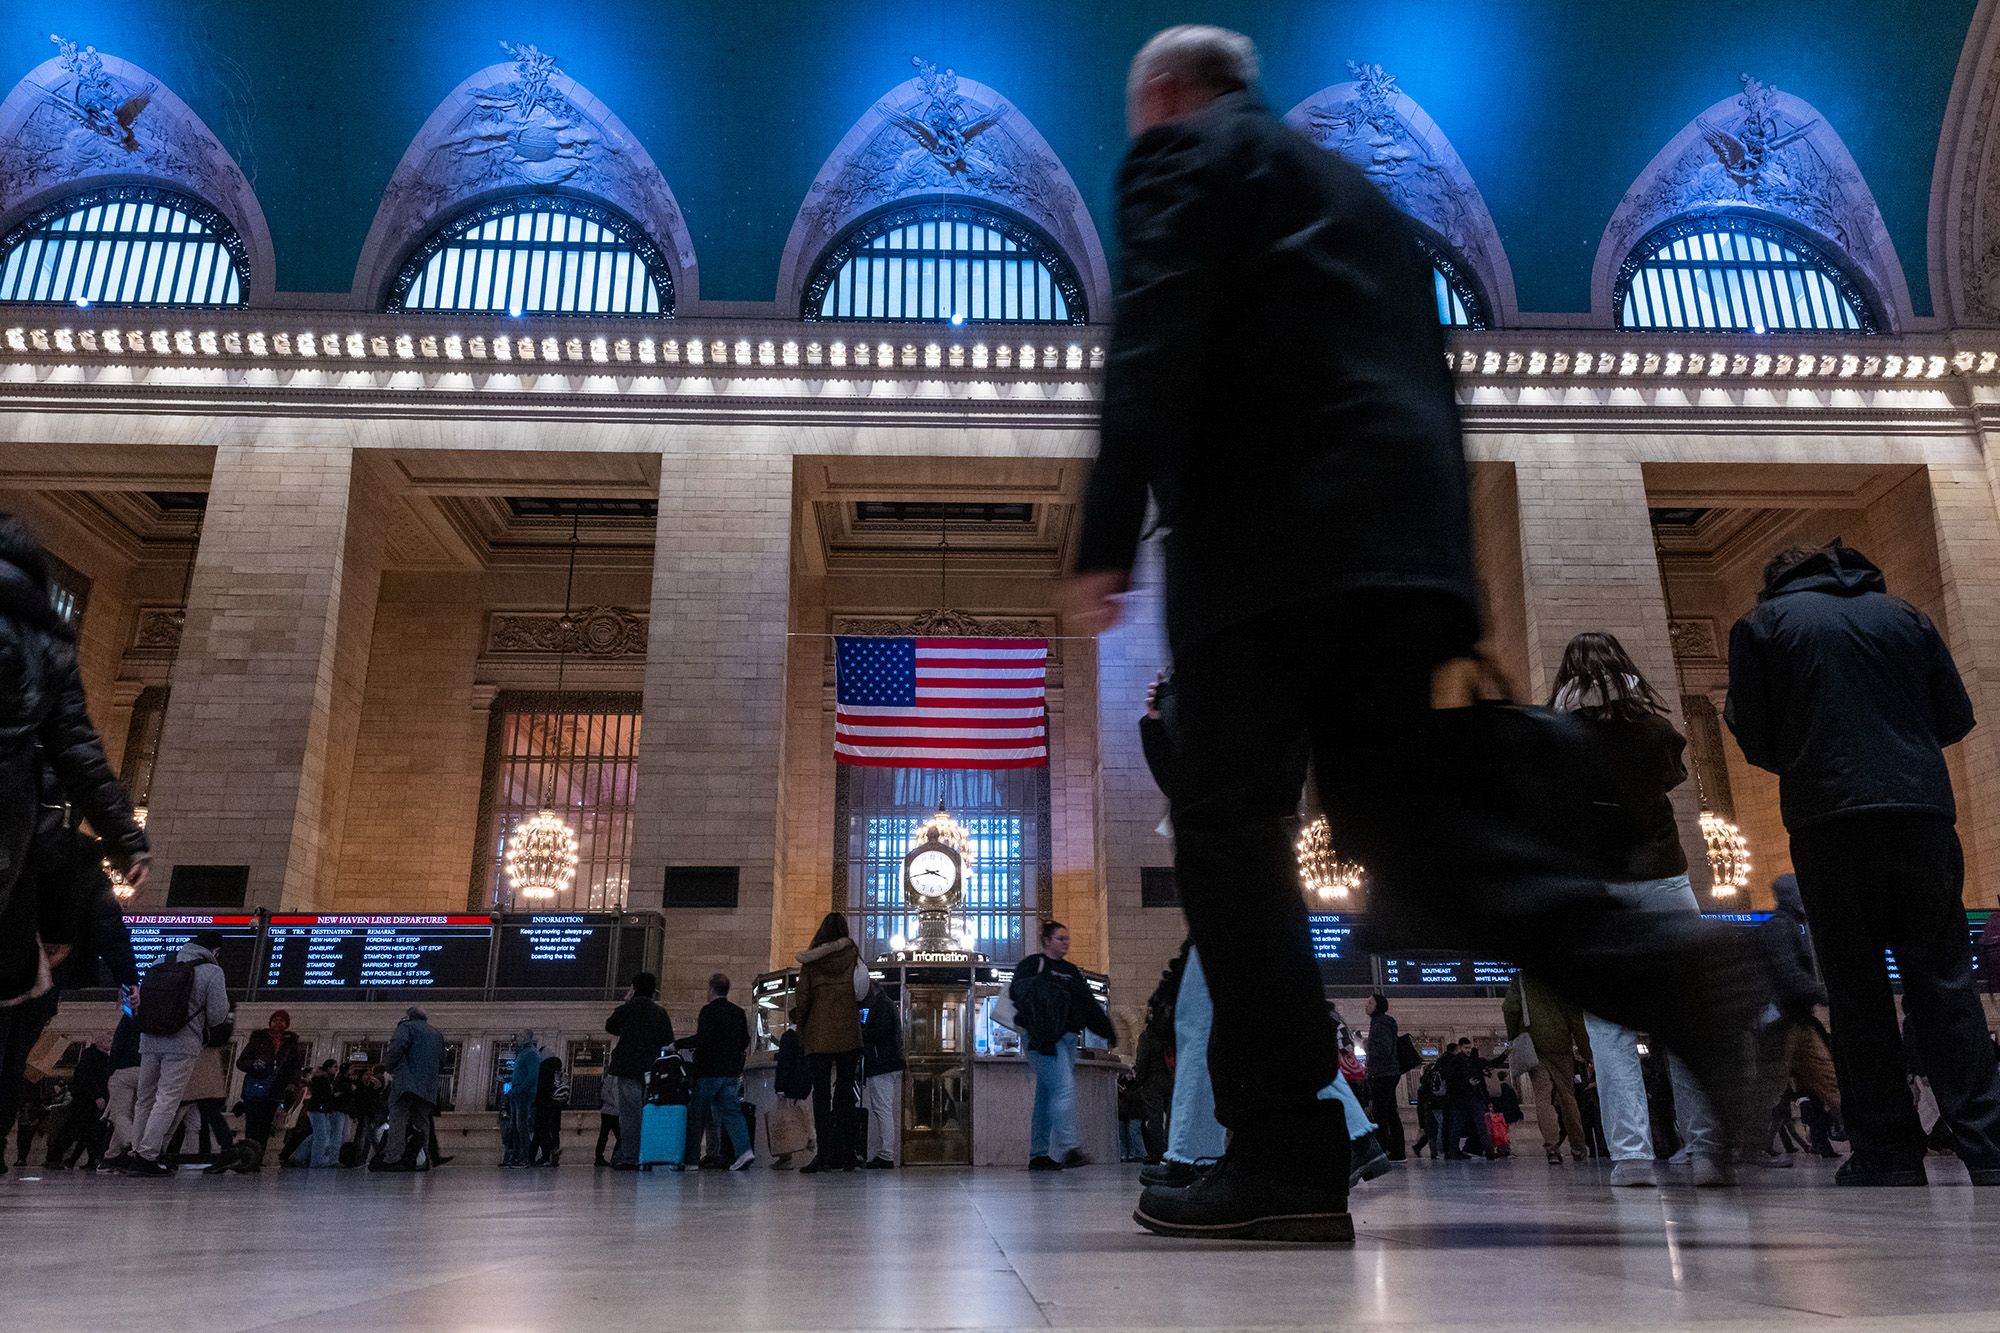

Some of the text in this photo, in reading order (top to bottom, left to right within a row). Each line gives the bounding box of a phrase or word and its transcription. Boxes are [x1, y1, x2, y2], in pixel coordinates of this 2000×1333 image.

[136, 916, 156, 924] LINE
[158, 916, 213, 924] DEPARTURES
[318, 916, 448, 924] NEW HAVEN LINE DEPARTURES
[912, 951, 968, 962] Information
